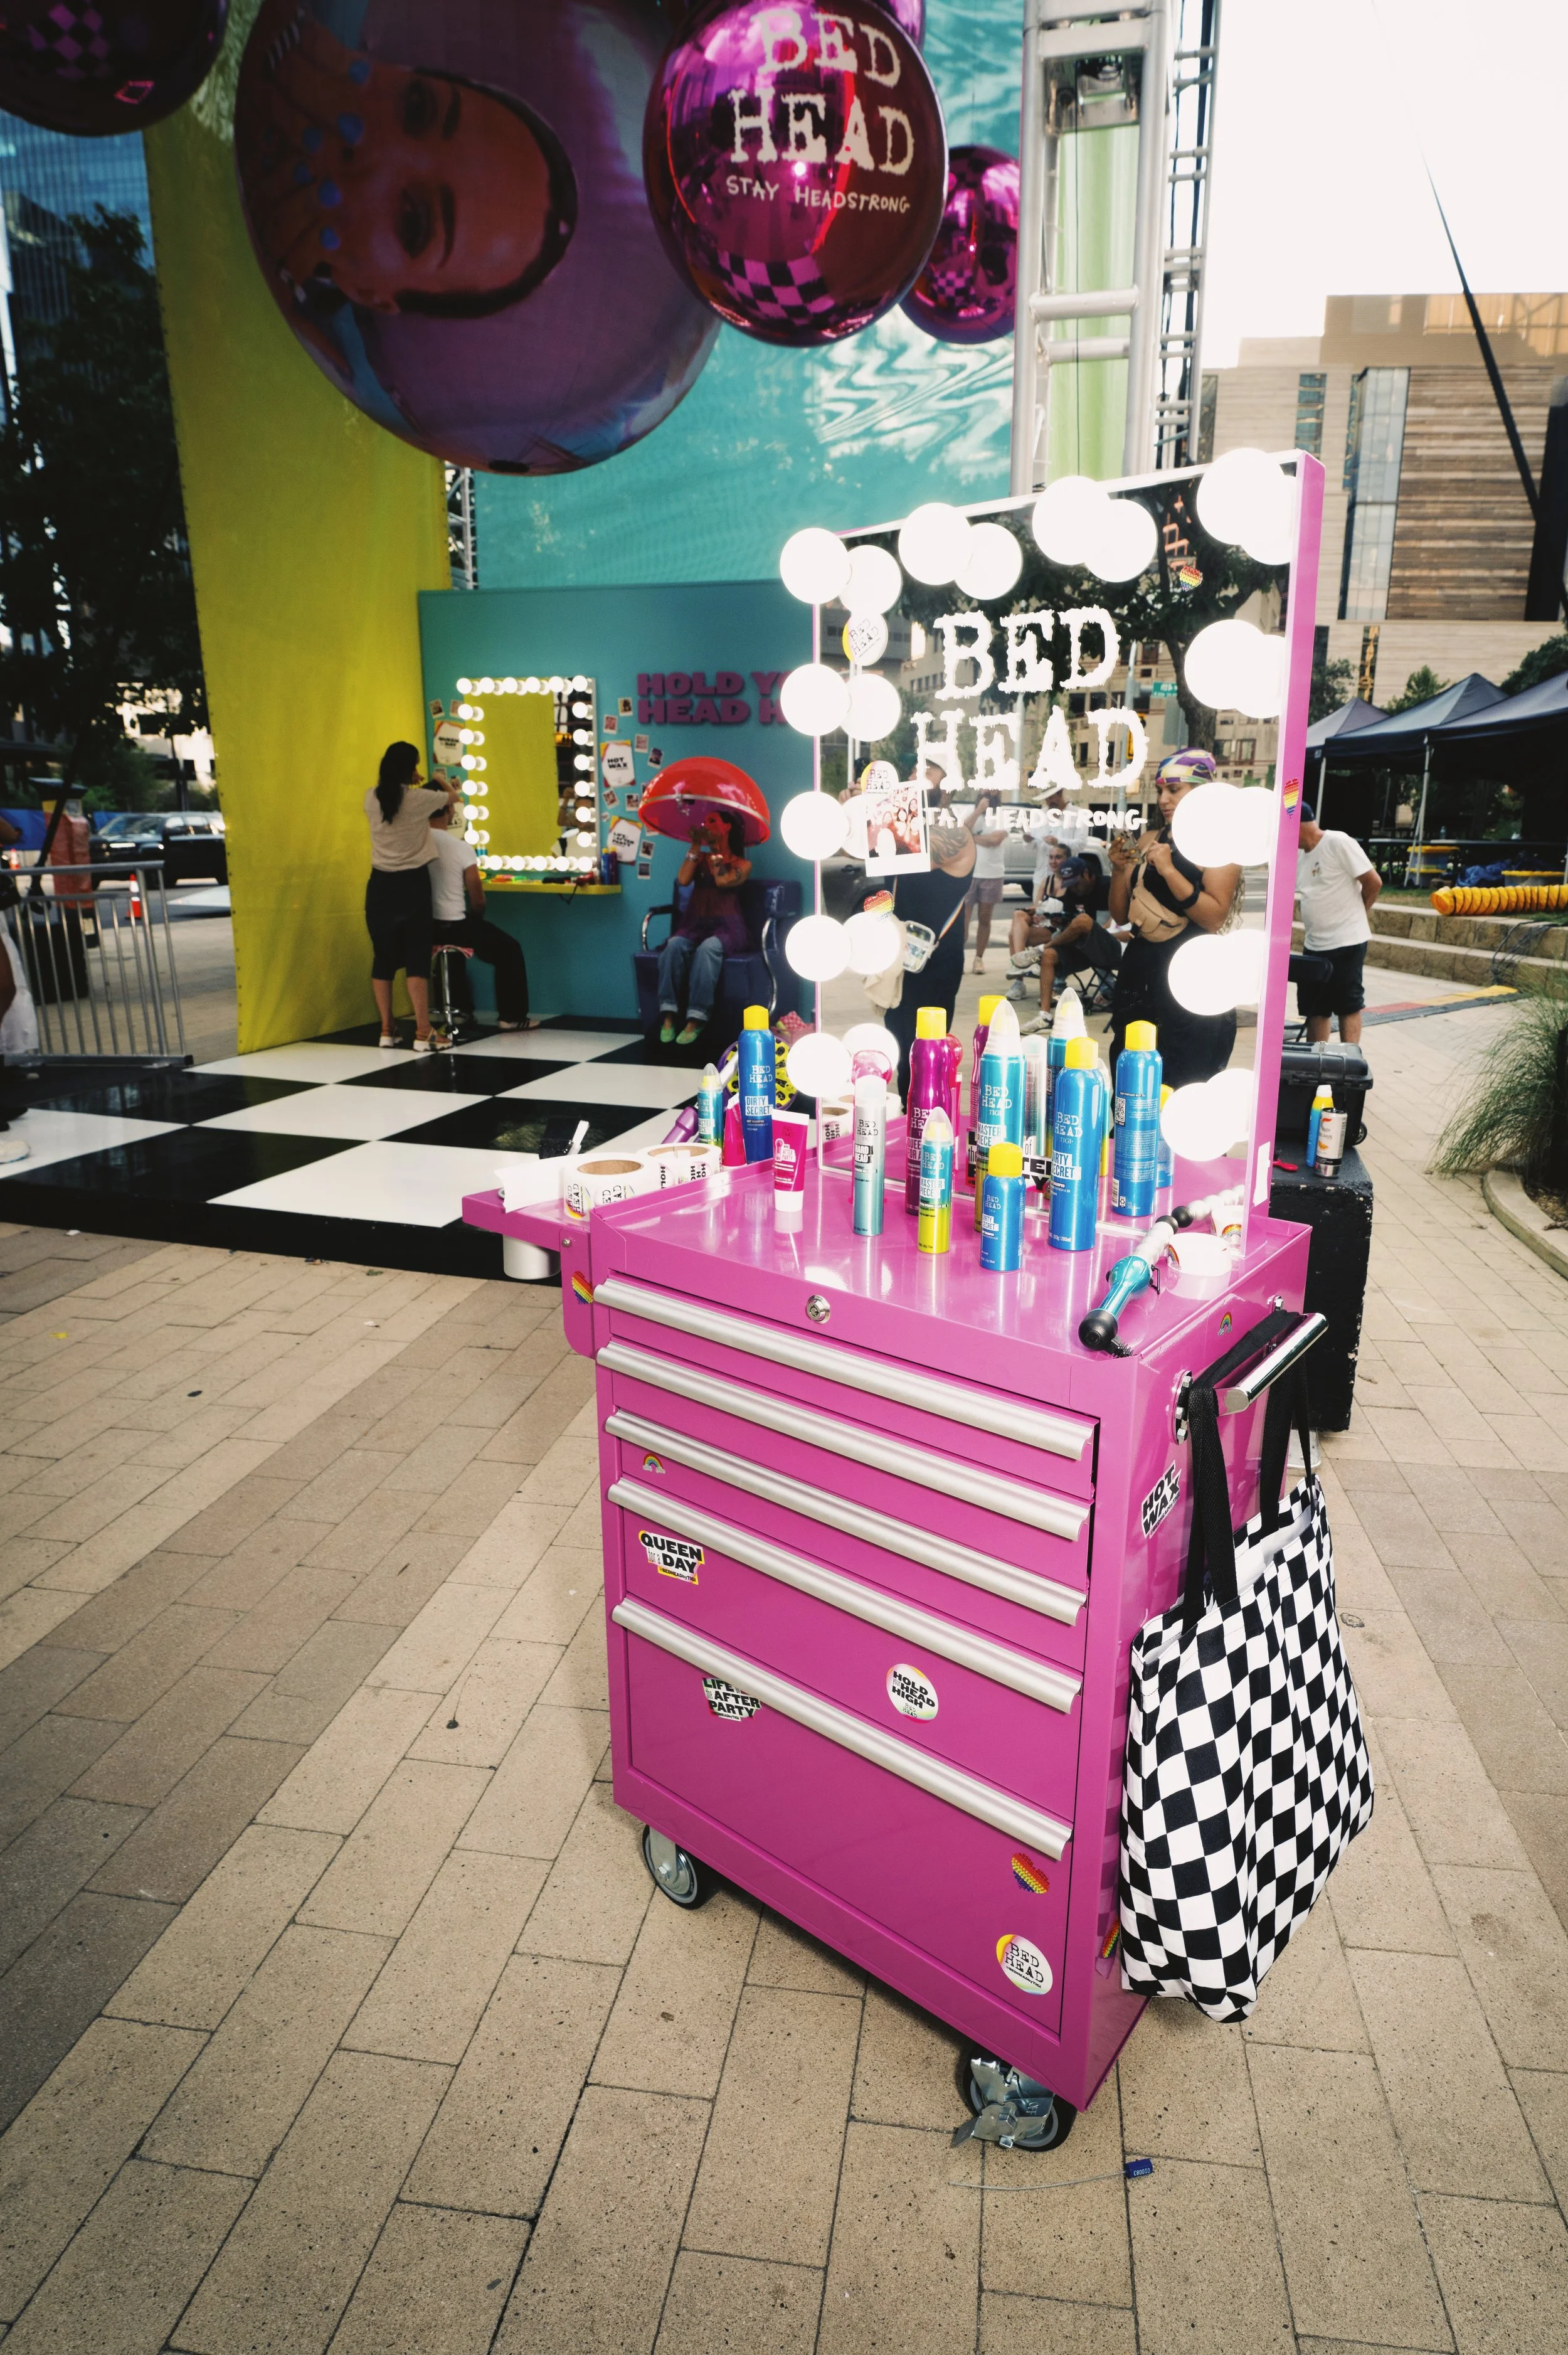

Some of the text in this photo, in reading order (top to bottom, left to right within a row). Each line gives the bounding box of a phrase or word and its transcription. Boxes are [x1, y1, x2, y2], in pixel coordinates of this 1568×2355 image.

[751, 8, 901, 87] BED
[727, 88, 914, 175] HEAD
[726, 175, 910, 214] STAY HEADSTRONG
[933, 604, 1121, 701] BED
[637, 672, 744, 696] HOLD
[638, 698, 750, 723] HEAD
[910, 705, 1149, 792] HEAD
[923, 804, 1148, 832] TAY HEADSTRONG
[752, 1065, 770, 1074] BED
[750, 1075, 773, 1083] HEAD
[985, 1085, 1009, 1098] BED
[746, 1097, 766, 1105] DIRTY
[982, 1096, 1012, 1109] HEAD
[746, 1106, 770, 1115] SECRET
[1057, 1112, 1079, 1125] BED
[857, 1127, 878, 1135] HEAD
[911, 1118, 925, 1129] HE
[1055, 1123, 1083, 1137] HEAD
[602, 1189, 611, 1203] ED
[987, 1194, 999, 1203] BED
[985, 1201, 1001, 1209] HEAD
[1143, 1464, 1175, 1519] HOT
[1143, 1475, 1180, 1535] WAX
[641, 1533, 702, 1561] QUEEN
[662, 1553, 696, 1573] DAY
[703, 1677, 734, 1692] LIFE
[893, 1671, 928, 1696] HOLD
[715, 1691, 760, 1708] AFTER
[892, 1686, 923, 1709] HIGH
[901, 1683, 935, 1707] HEAD
[708, 1700, 754, 1718] PARTY
[903, 1706, 917, 1718] HEAD
[905, 1703, 916, 1713] BED
[1009, 1942, 1039, 1967] BED
[1005, 1952, 1044, 1983] HEAD
[1133, 2167, 1150, 2176] 010083
